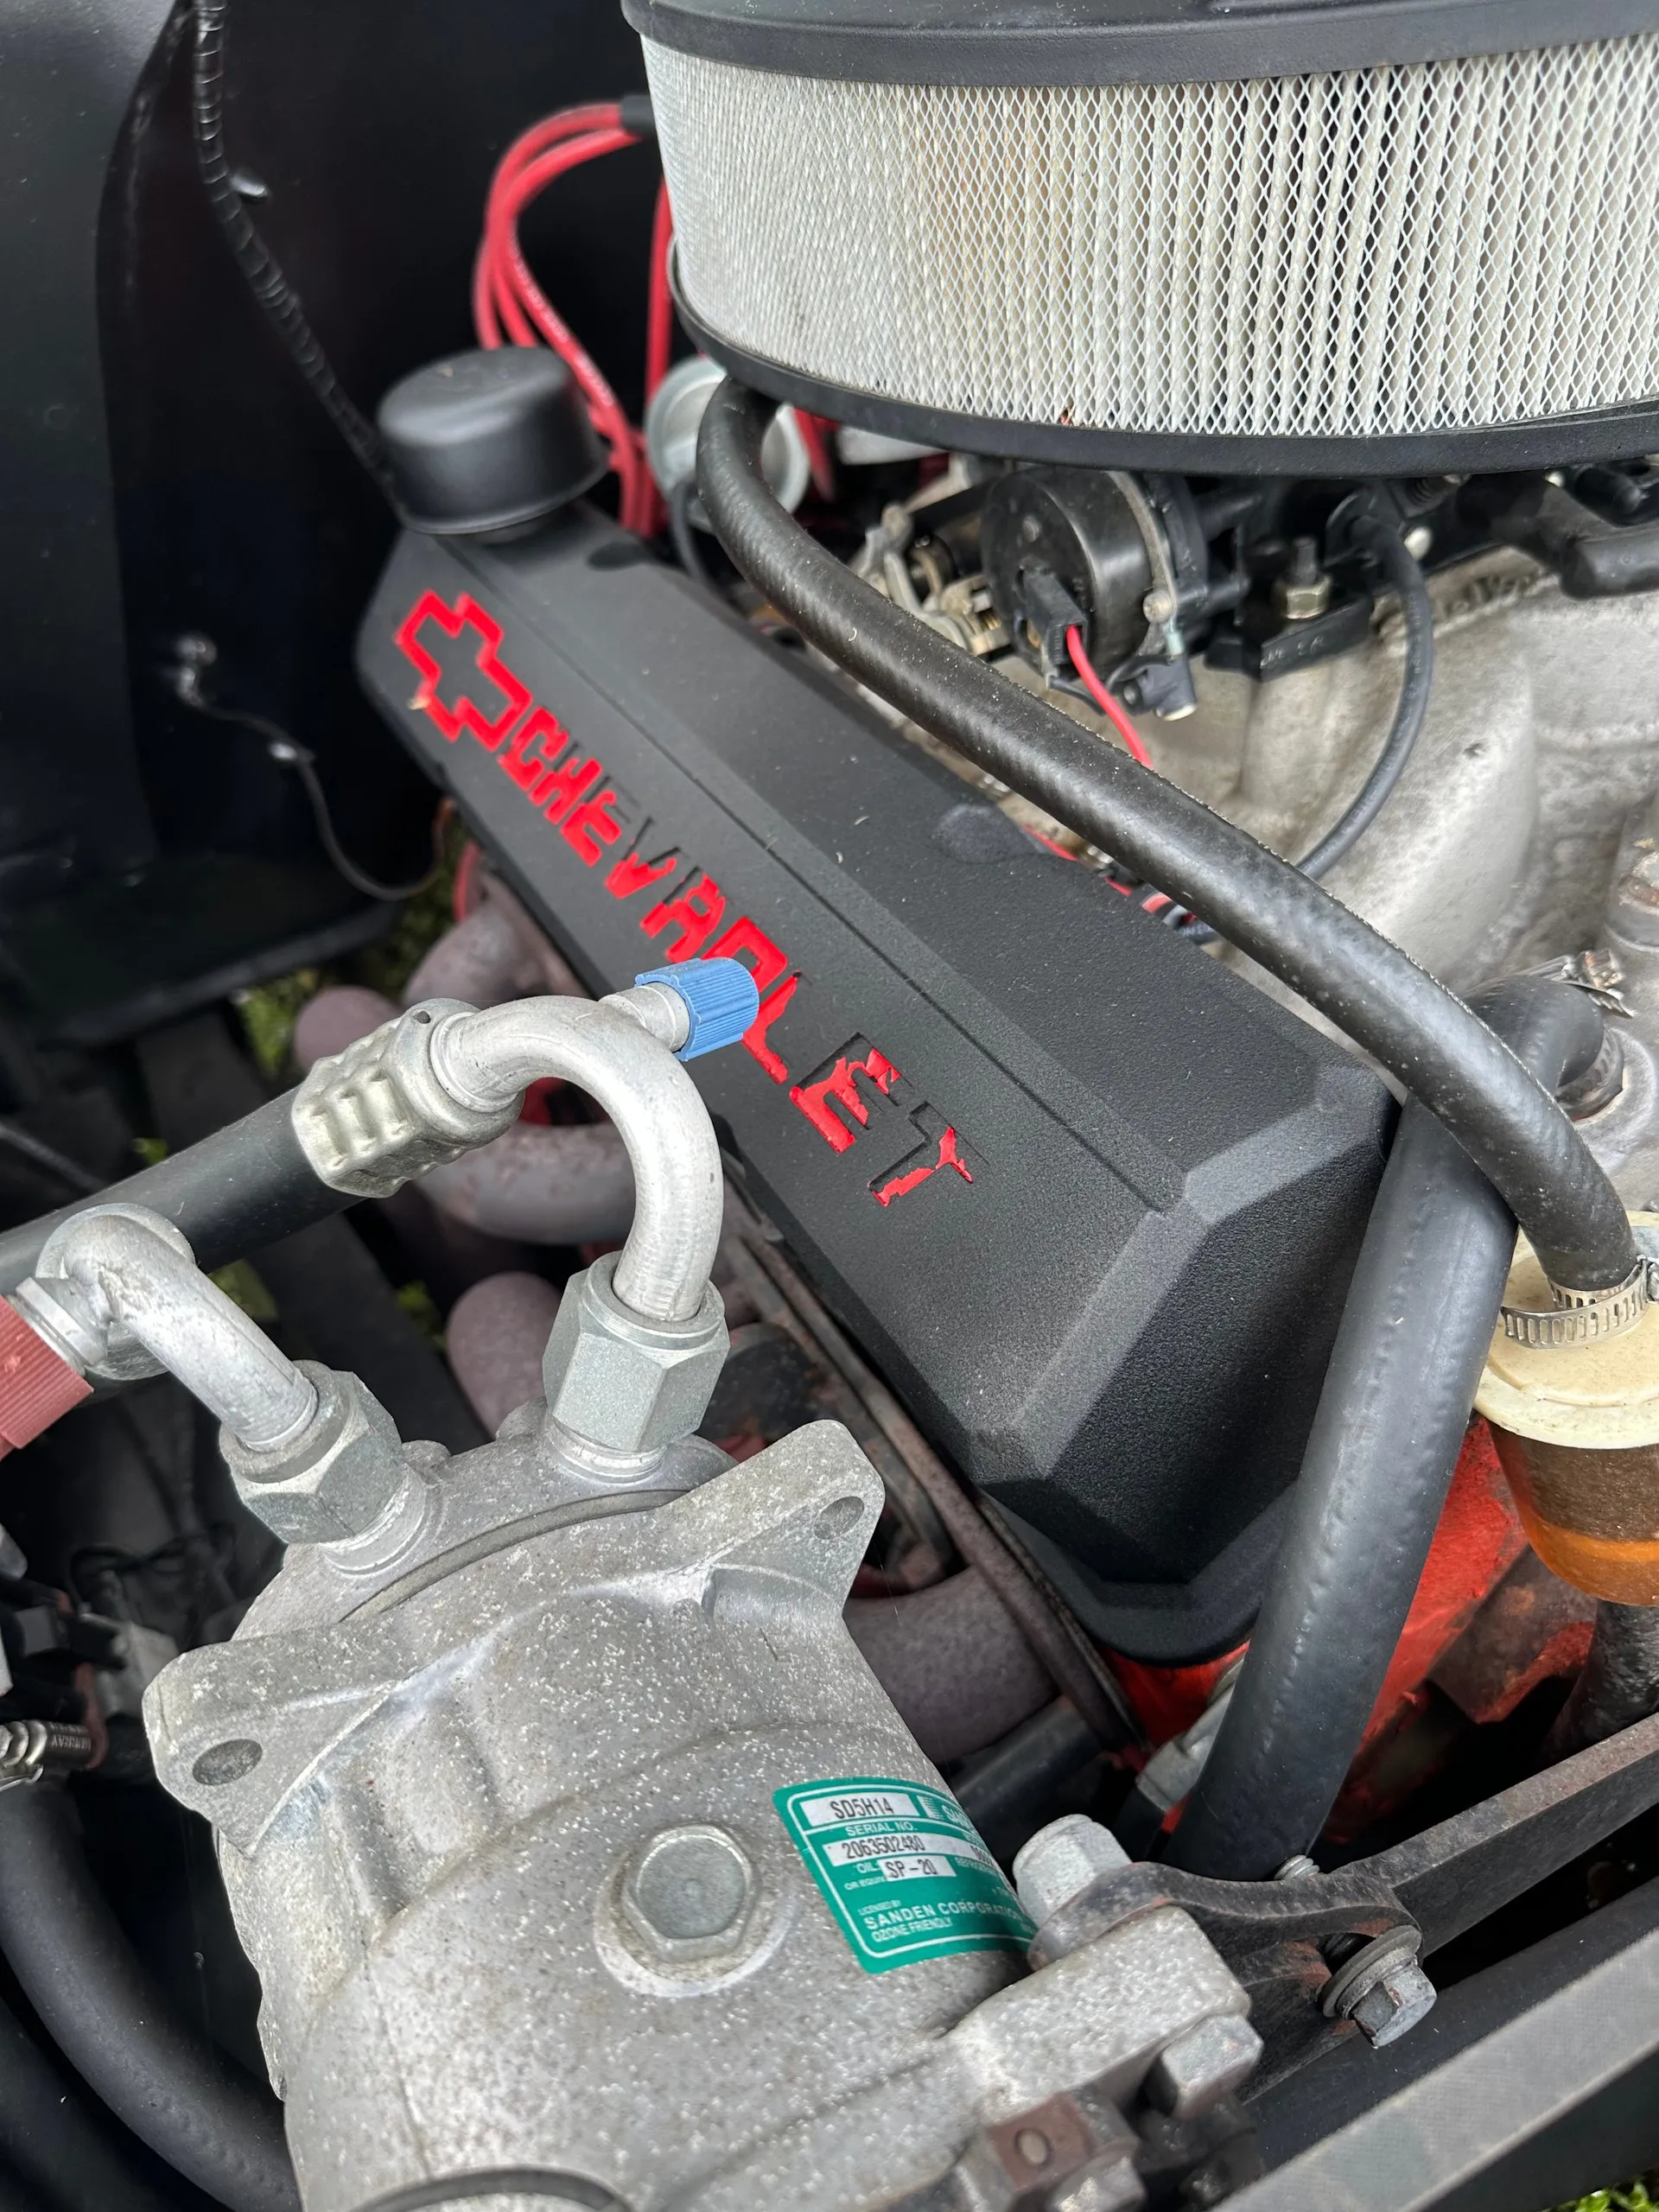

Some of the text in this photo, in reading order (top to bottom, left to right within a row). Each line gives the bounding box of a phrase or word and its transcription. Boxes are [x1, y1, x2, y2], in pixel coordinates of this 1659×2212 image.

[829, 1797, 895, 1820] SD5H14
[845, 1821, 918, 1837] SERIAL NO.
[864, 1904, 937, 1929] SANDEN
[871, 1916, 953, 1943] OZONE FRIENDLY
